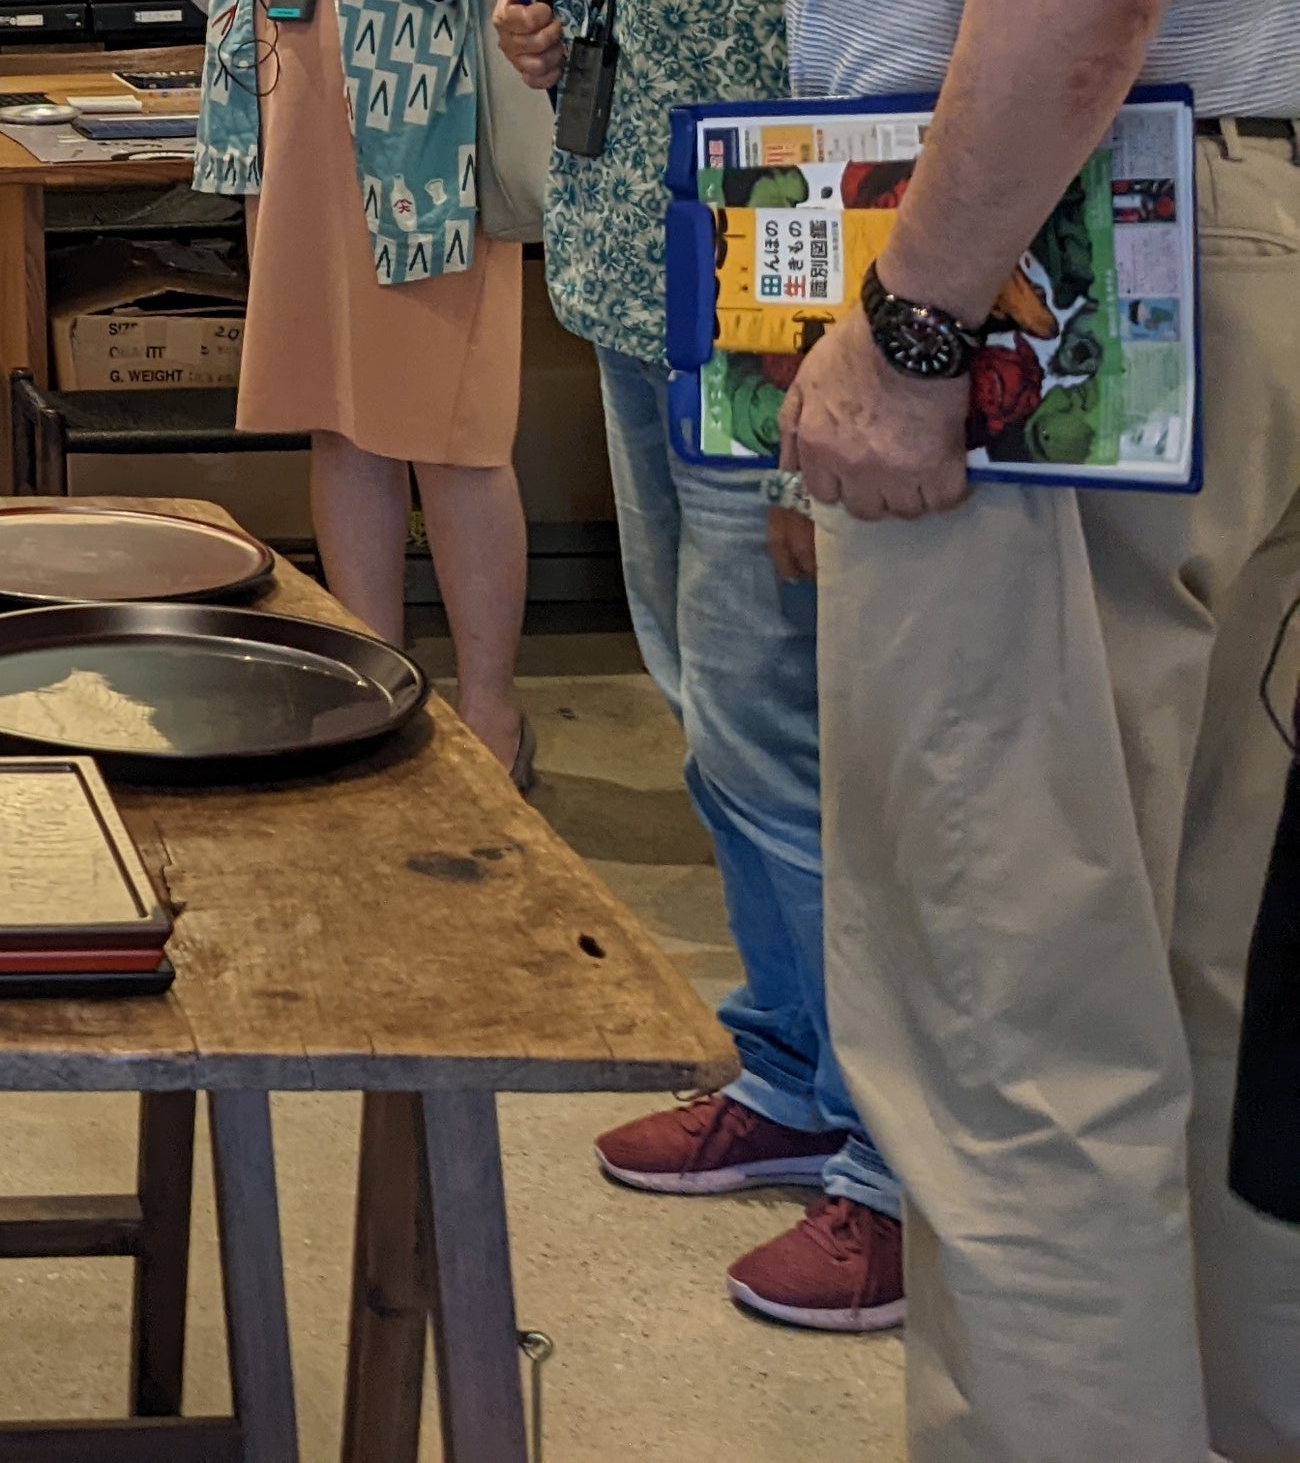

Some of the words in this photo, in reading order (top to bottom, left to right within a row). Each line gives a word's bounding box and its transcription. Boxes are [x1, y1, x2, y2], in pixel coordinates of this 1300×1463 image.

[784, 221, 807, 298] 生きもの
[110, 370, 124, 383] G.
[128, 369, 183, 383] WEIGHT
